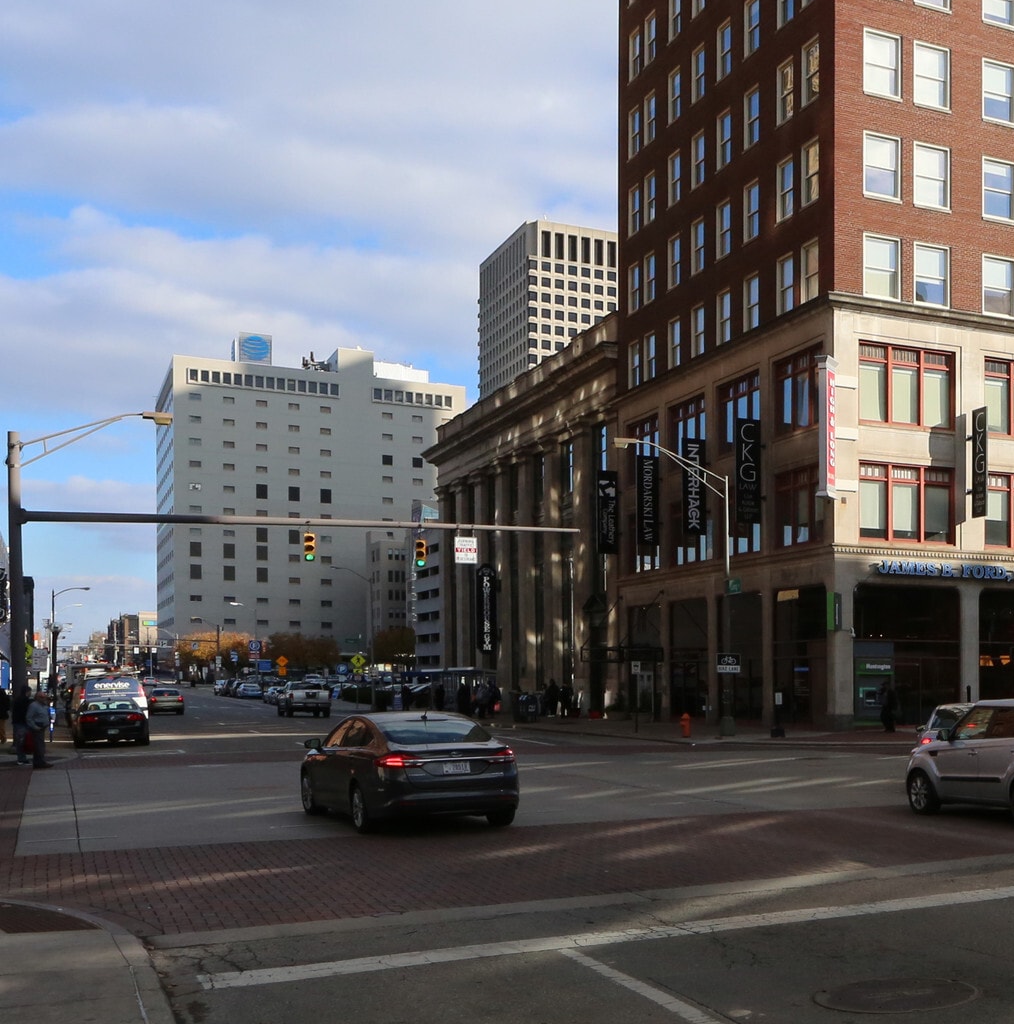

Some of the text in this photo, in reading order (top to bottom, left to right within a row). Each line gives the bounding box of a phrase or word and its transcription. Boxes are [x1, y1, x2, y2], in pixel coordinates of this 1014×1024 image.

[740, 423, 756, 482] CKG
[975, 412, 985, 474] CKG
[607, 500, 616, 513] The
[642, 459, 654, 542] MORDARSKI LAW
[878, 559, 938, 576] JAMES
[942, 563, 956, 577] B.
[962, 564, 1013, 582] FORD,
[94, 681, 131, 690] enervise
